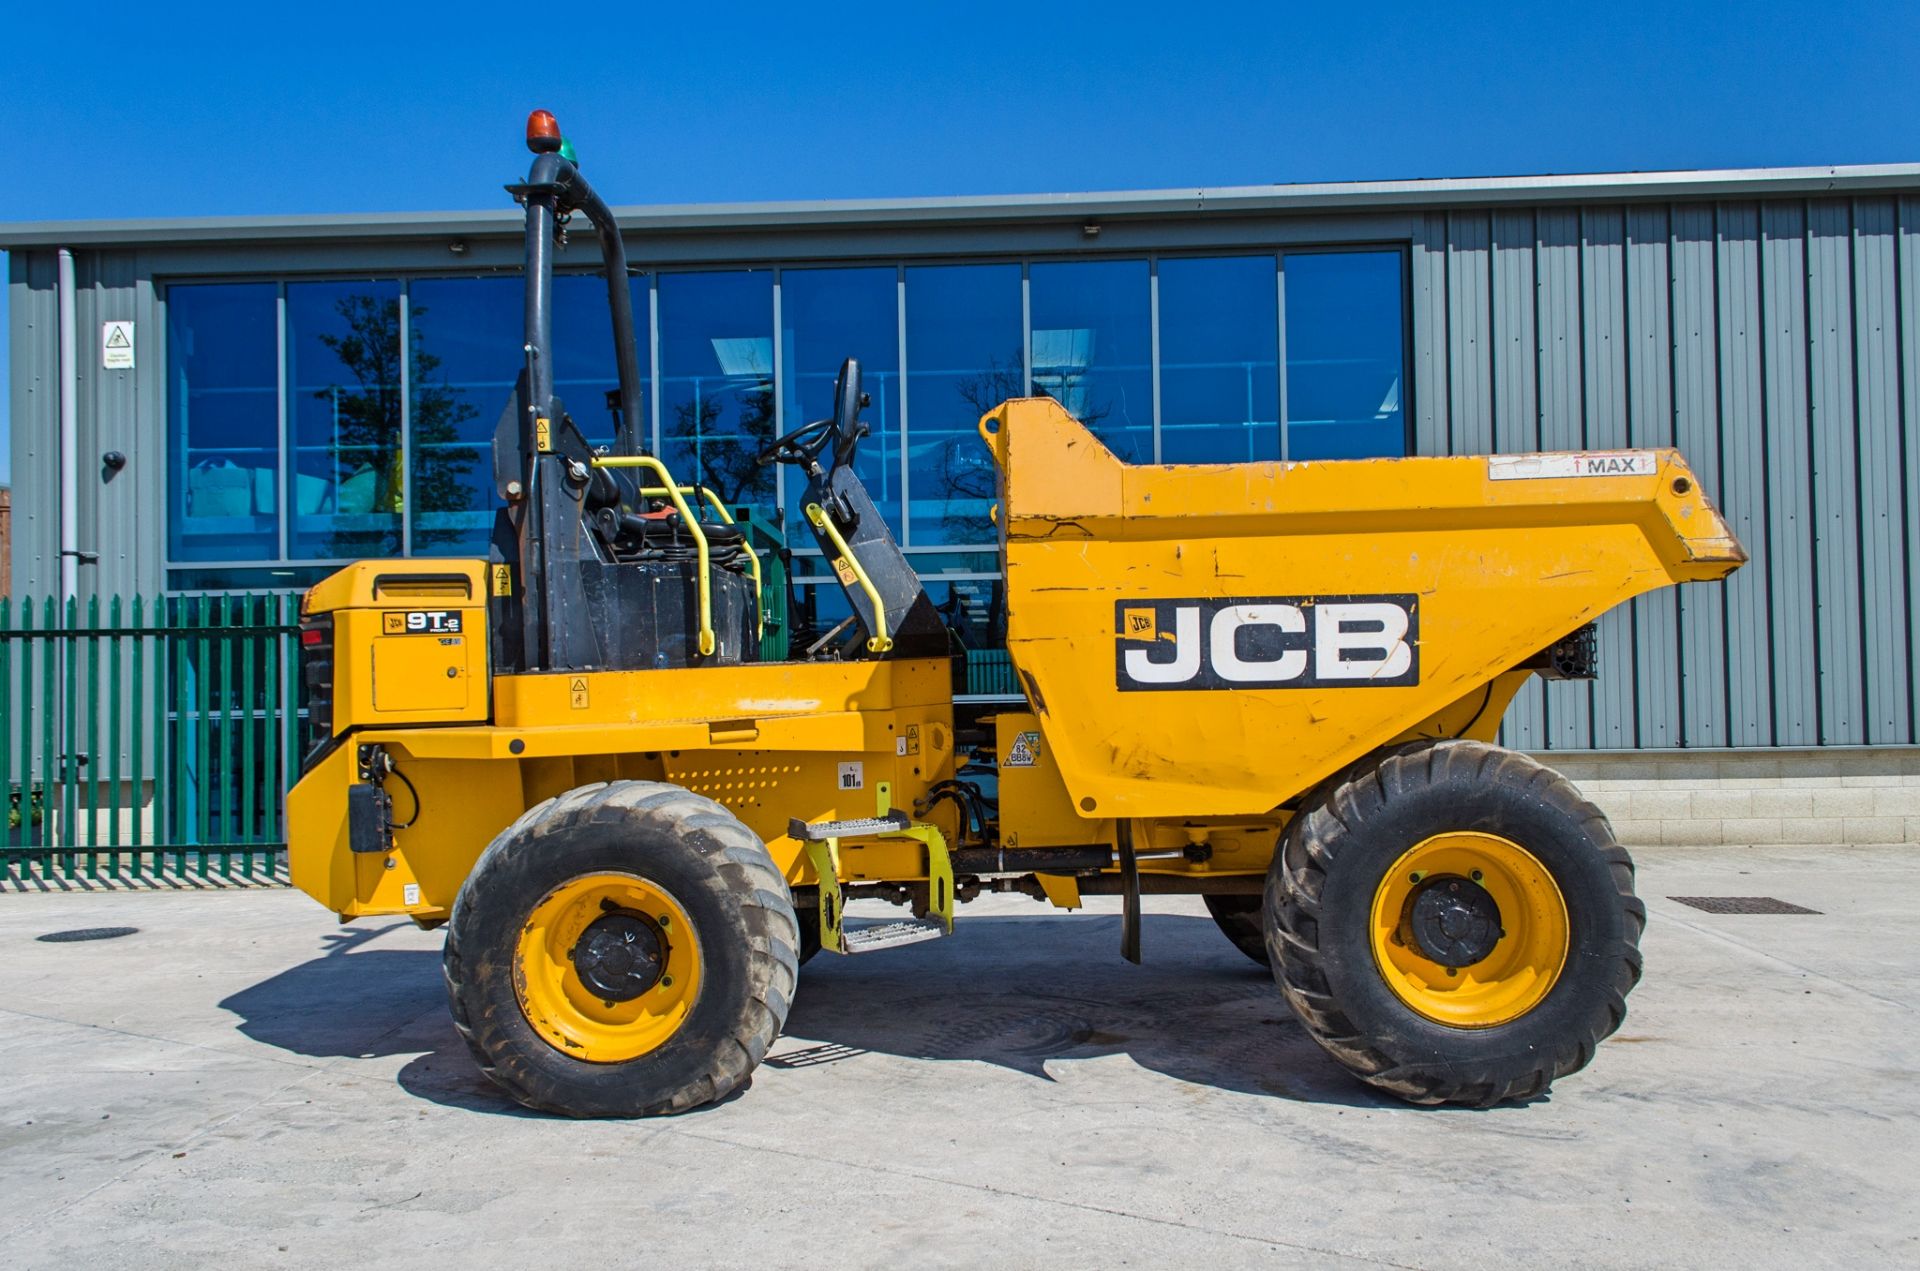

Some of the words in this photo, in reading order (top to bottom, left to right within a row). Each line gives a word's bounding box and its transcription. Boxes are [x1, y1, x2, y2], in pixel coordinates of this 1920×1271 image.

[1588, 458, 1635, 474] MAX
[1132, 616, 1151, 631] JCB
[1125, 603, 1412, 683] JCB
[842, 773, 856, 787] 101
